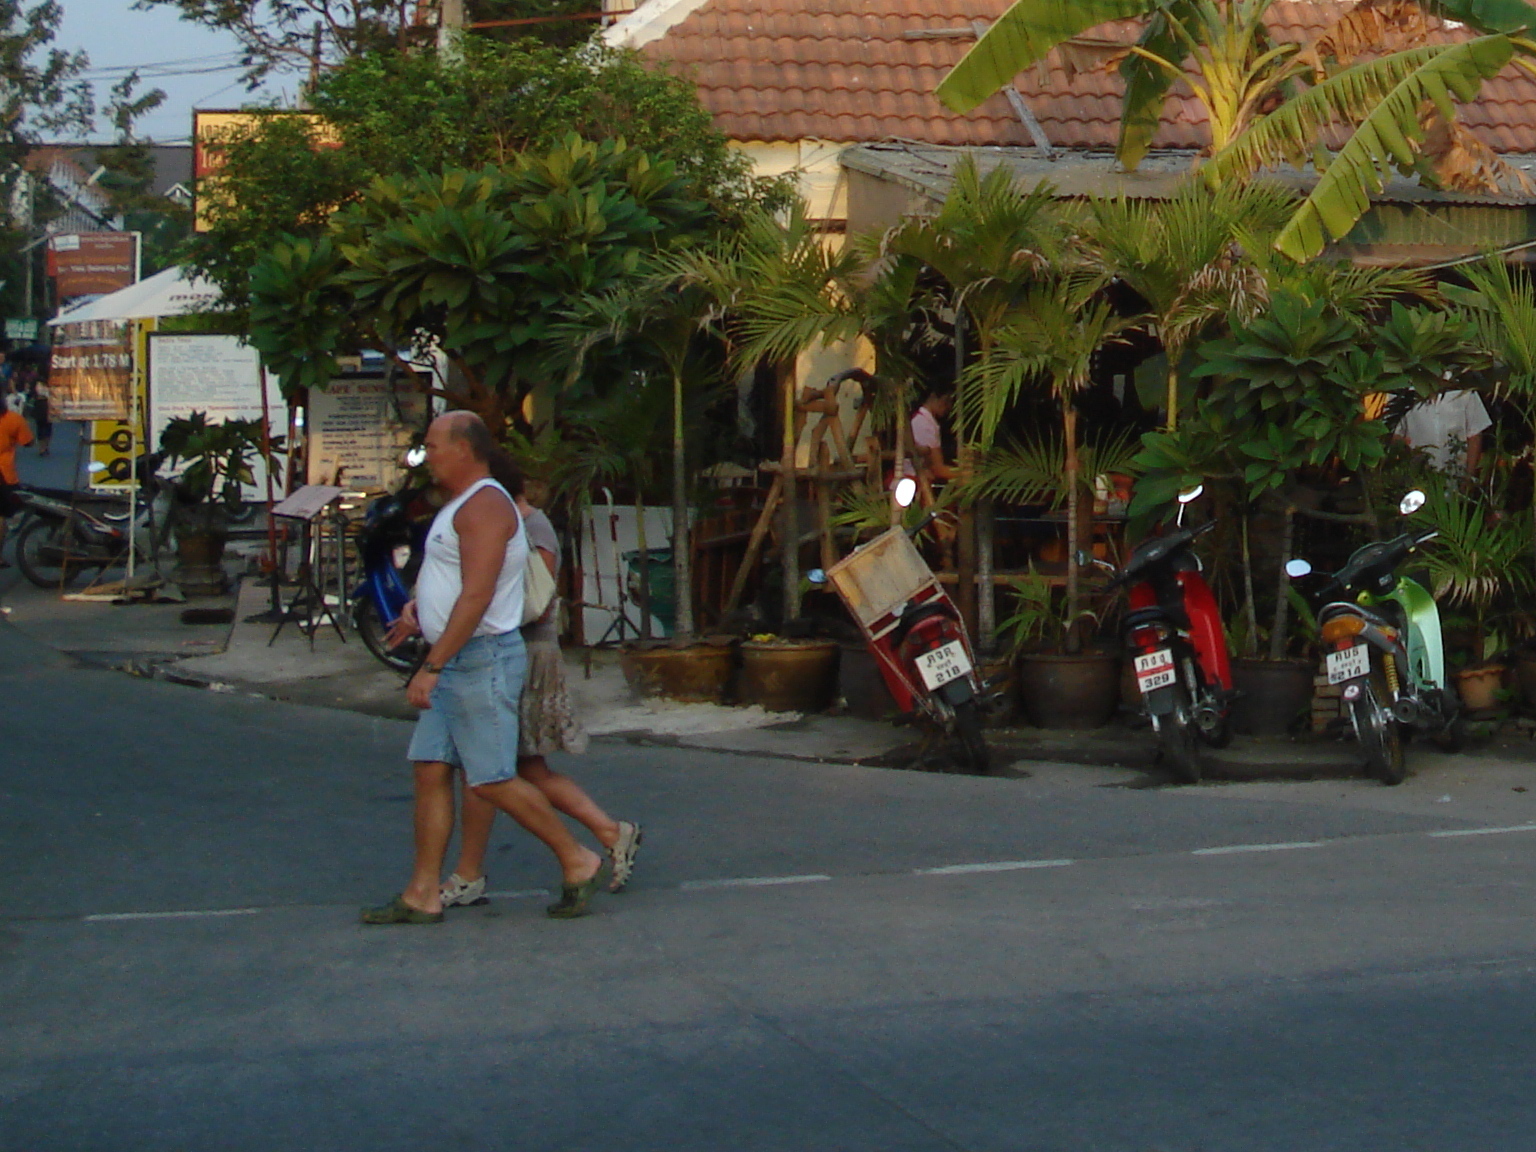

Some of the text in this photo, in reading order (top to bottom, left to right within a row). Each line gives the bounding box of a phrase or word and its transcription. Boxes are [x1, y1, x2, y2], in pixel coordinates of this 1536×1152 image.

[51, 354, 76, 369] Start
[92, 354, 116, 368] 1.78
[935, 665, 961, 683] 218
[1144, 673, 1169, 688] 329
